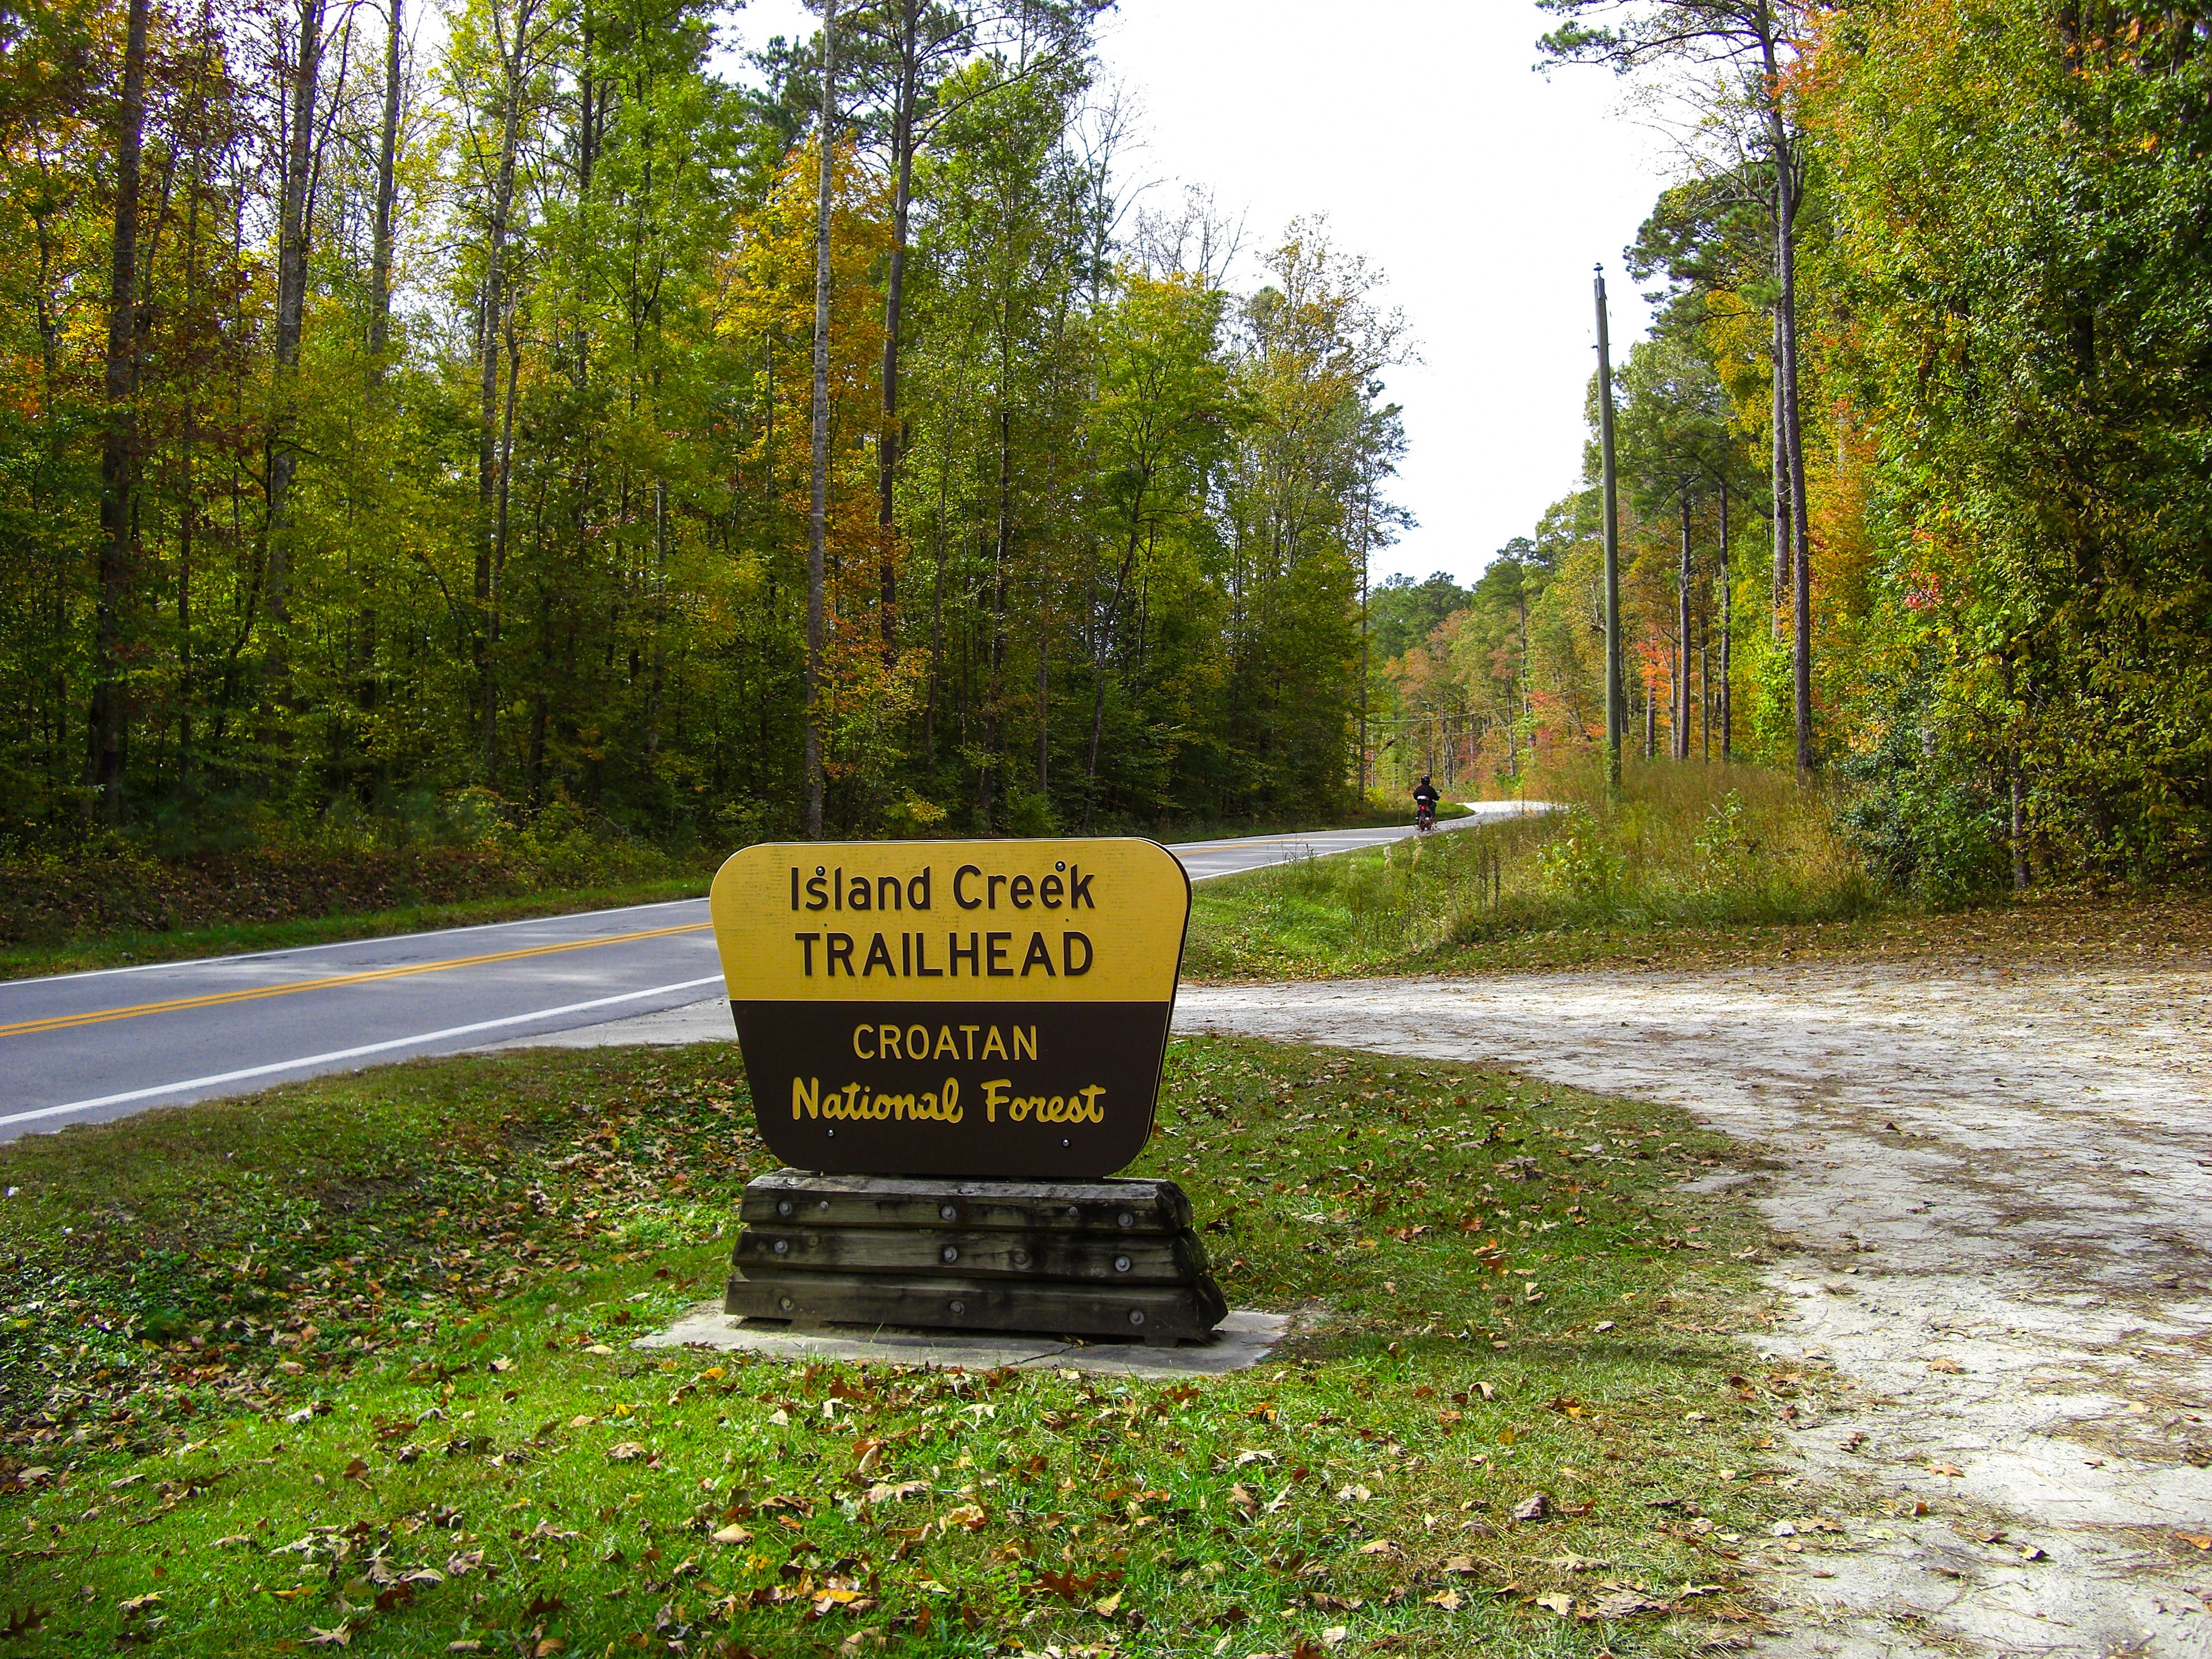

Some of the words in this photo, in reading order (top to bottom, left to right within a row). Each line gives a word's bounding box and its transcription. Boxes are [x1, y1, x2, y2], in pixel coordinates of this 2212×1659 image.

[791, 865, 931, 911] Island
[953, 863, 1096, 910] Creek
[794, 931, 1093, 977] TRAILHEAD
[853, 1023, 1037, 1061] CROATAN
[791, 1077, 963, 1123] National
[980, 1078, 1107, 1124] Forest
